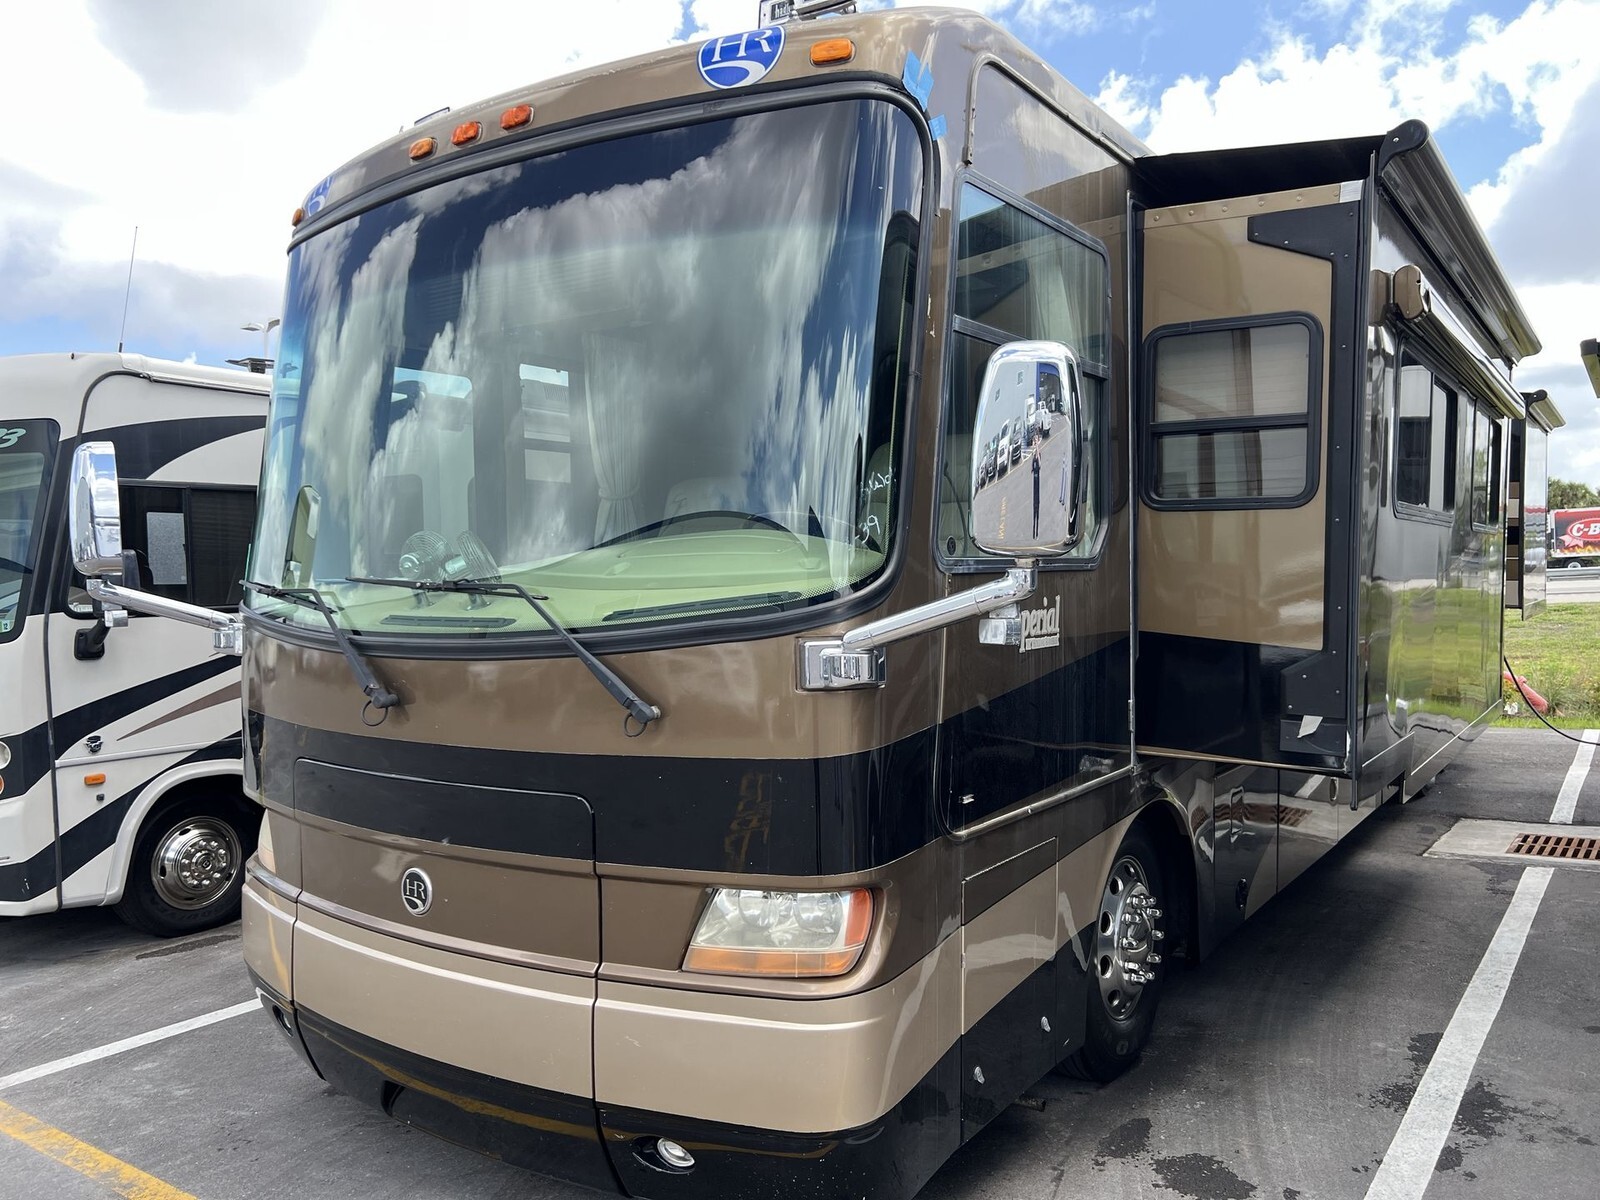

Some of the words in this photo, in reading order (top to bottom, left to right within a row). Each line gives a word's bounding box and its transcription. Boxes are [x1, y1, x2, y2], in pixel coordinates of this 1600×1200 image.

[711, 29, 773, 63] HR
[1019, 594, 1061, 653] perial
[405, 878, 426, 900] HR
